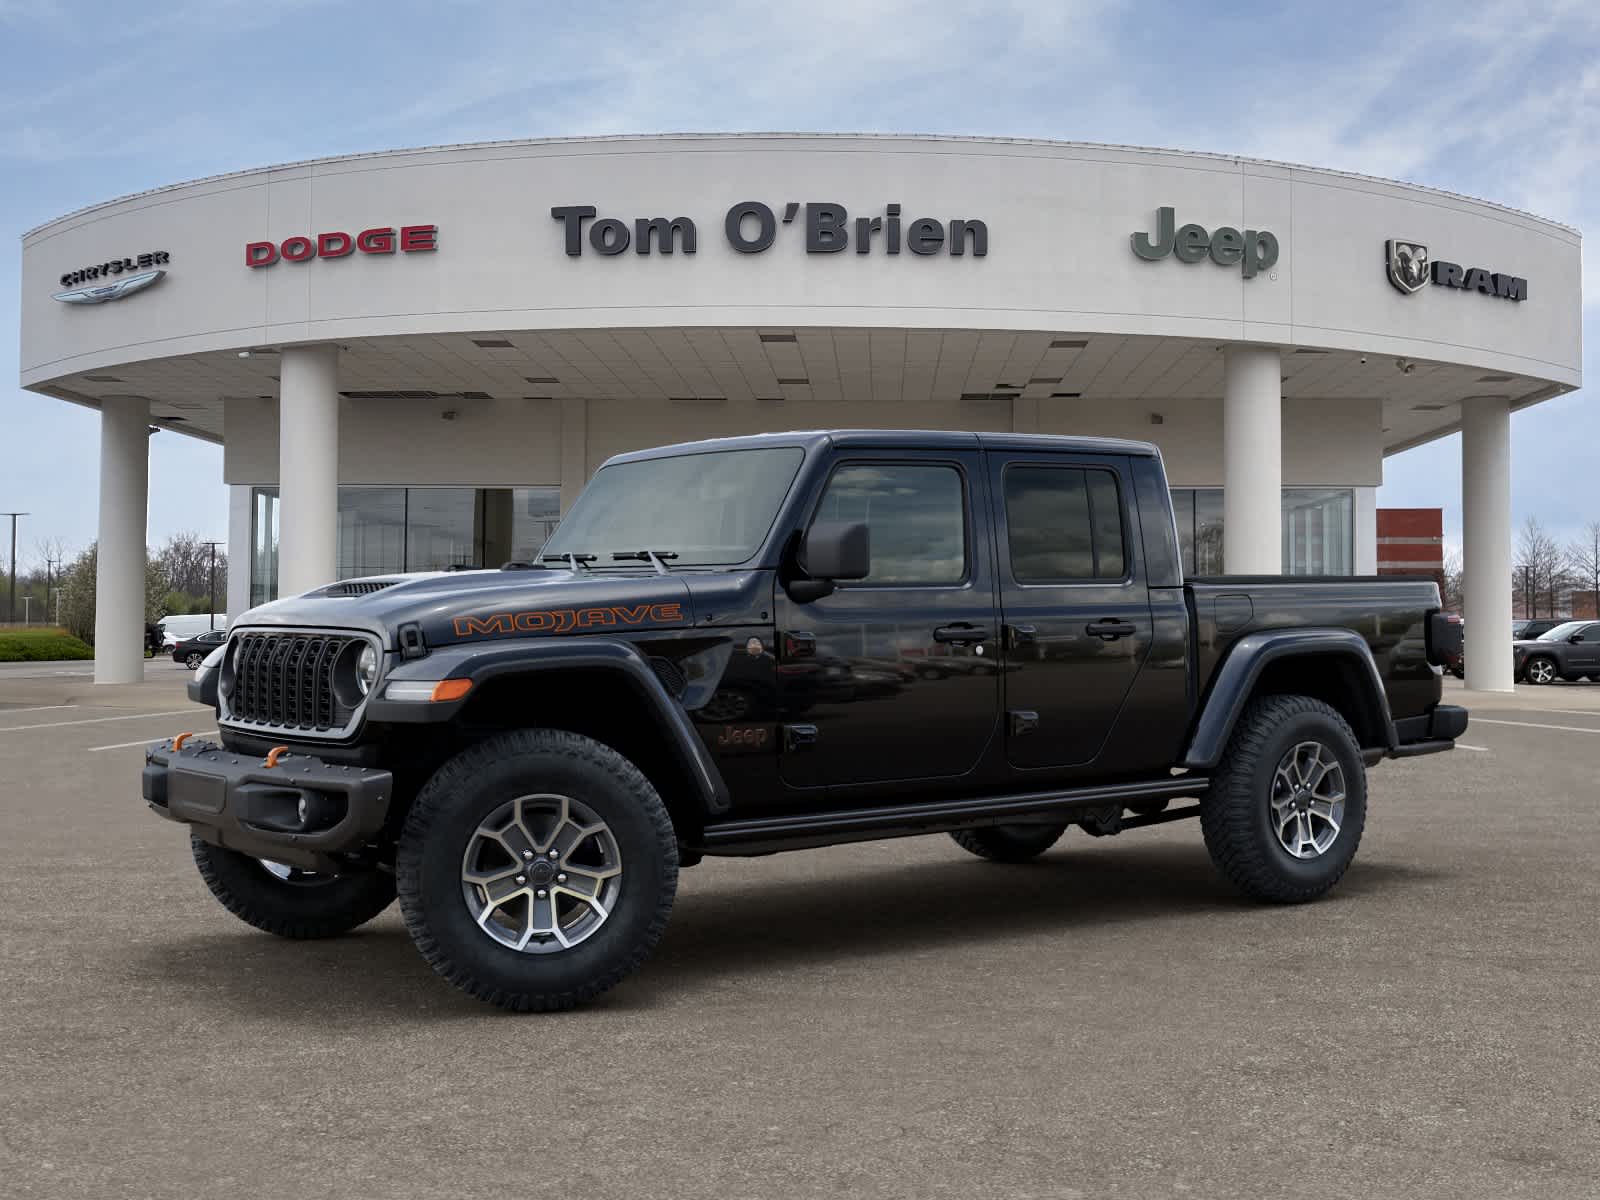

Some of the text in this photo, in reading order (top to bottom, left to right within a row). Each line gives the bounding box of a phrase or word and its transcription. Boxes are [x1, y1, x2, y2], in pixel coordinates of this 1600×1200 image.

[245, 225, 437, 269] DODGE
[551, 201, 989, 257] Tom O'Brien
[1130, 206, 1279, 279] Jeep
[60, 250, 170, 287] CHRYSLER
[1431, 260, 1528, 301] RAM
[454, 603, 683, 637] MOJAVE
[718, 725, 768, 747] Jeep
